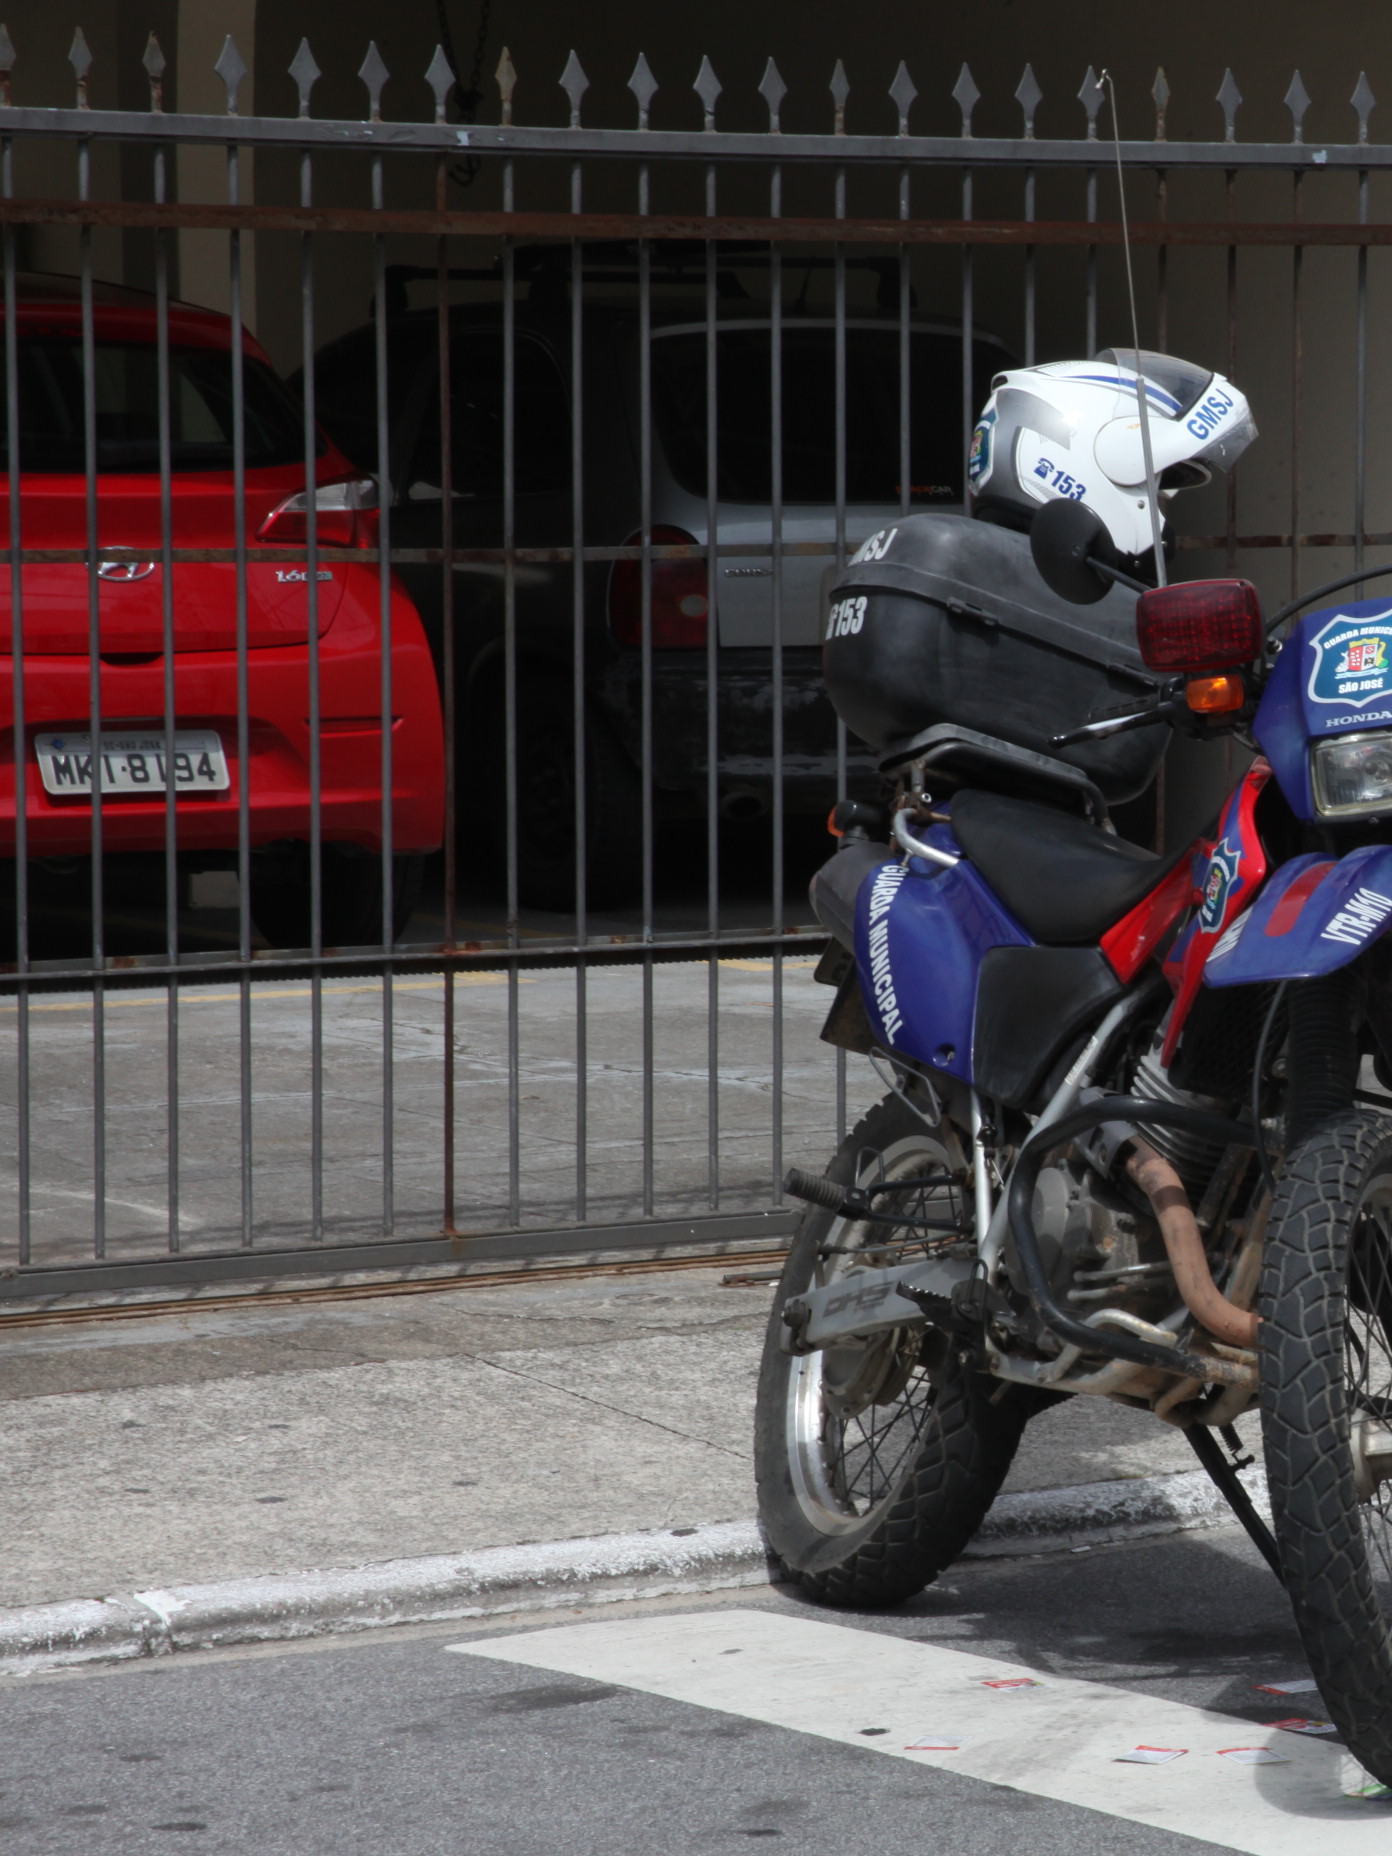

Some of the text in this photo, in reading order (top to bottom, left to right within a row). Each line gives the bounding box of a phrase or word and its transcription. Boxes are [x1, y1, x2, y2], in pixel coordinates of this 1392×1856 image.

[1186, 388, 1235, 441] GMSJ
[1050, 469, 1087, 501] 153
[1324, 629, 1359, 650] GUARDA
[1338, 677, 1384, 694] SÃO JOSÉ
[868, 864, 910, 1046] GUARDA MUNICIPAL
